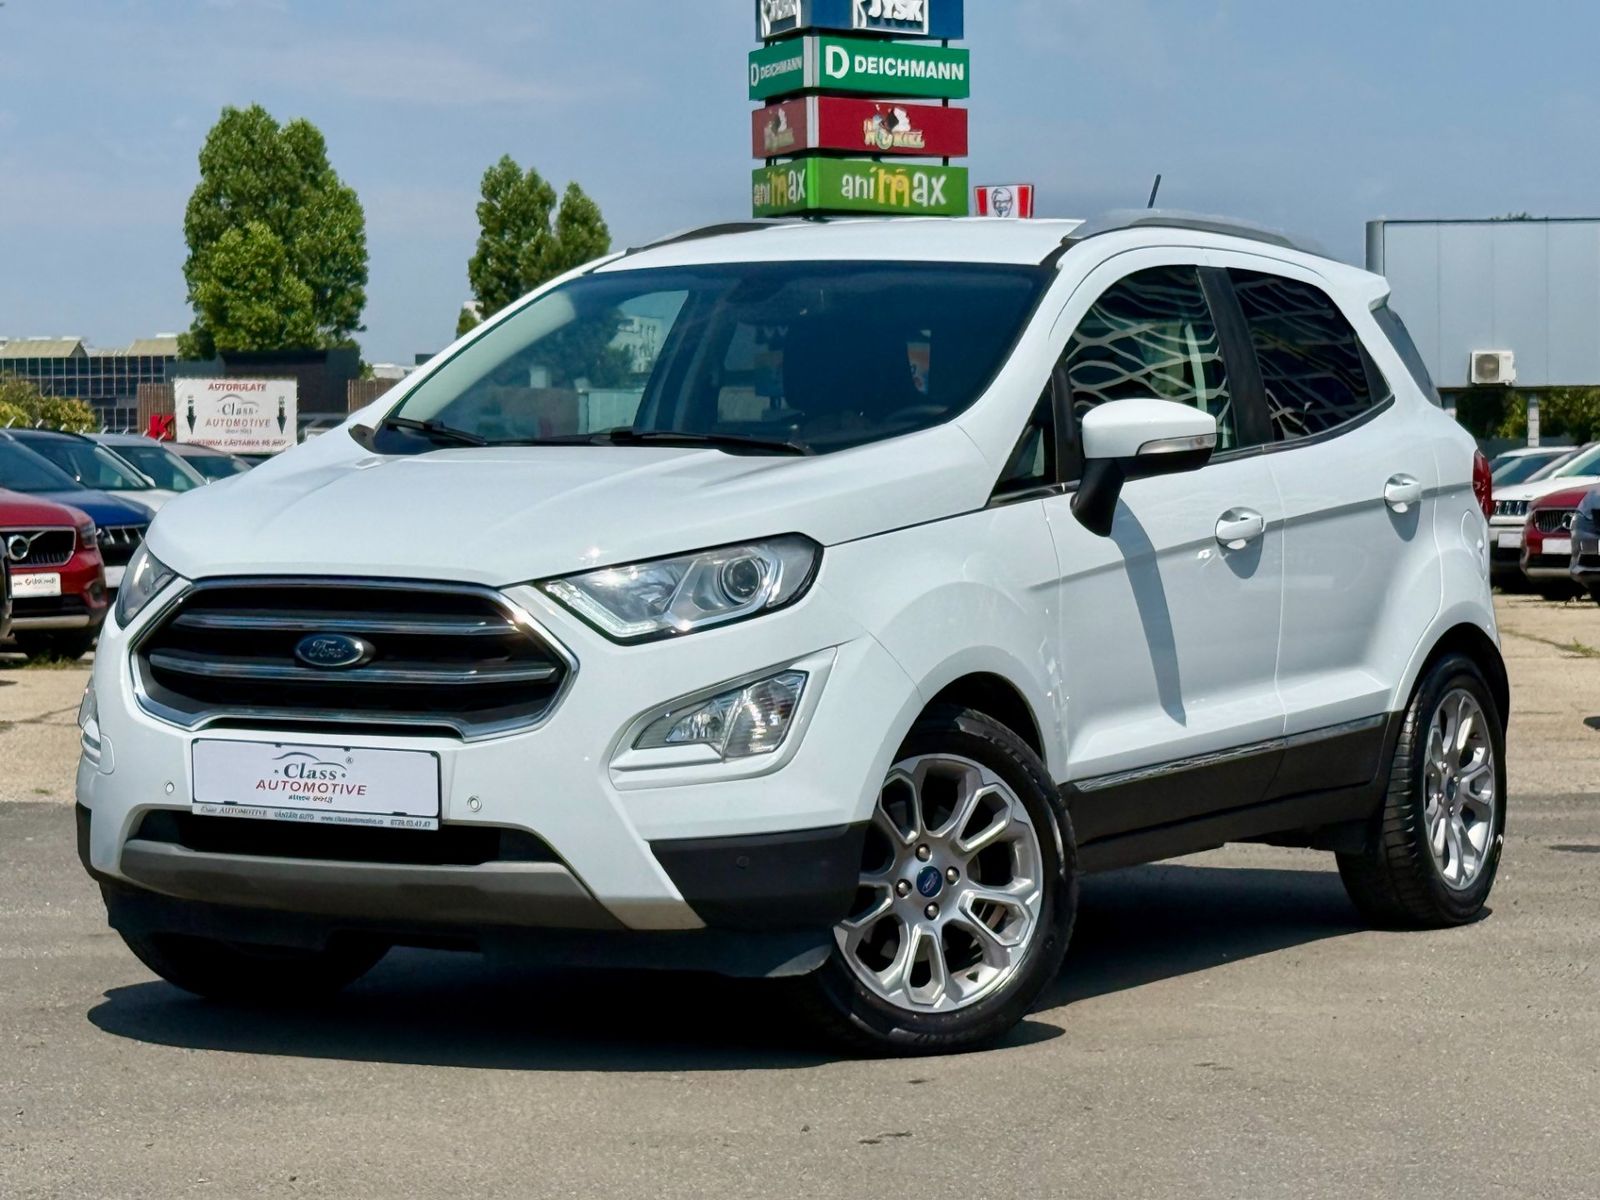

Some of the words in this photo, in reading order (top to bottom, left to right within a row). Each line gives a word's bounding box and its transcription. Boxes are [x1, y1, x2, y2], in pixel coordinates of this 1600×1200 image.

[854, 54, 964, 81] DEICHMANN
[841, 167, 947, 208] animax
[221, 402, 255, 416] Class
[205, 418, 271, 428] AUTOMOTIVE
[284, 763, 337, 780] Class
[255, 779, 368, 796] AUTOMOTIVE
[219, 807, 268, 817] AUTOMOTIVE
